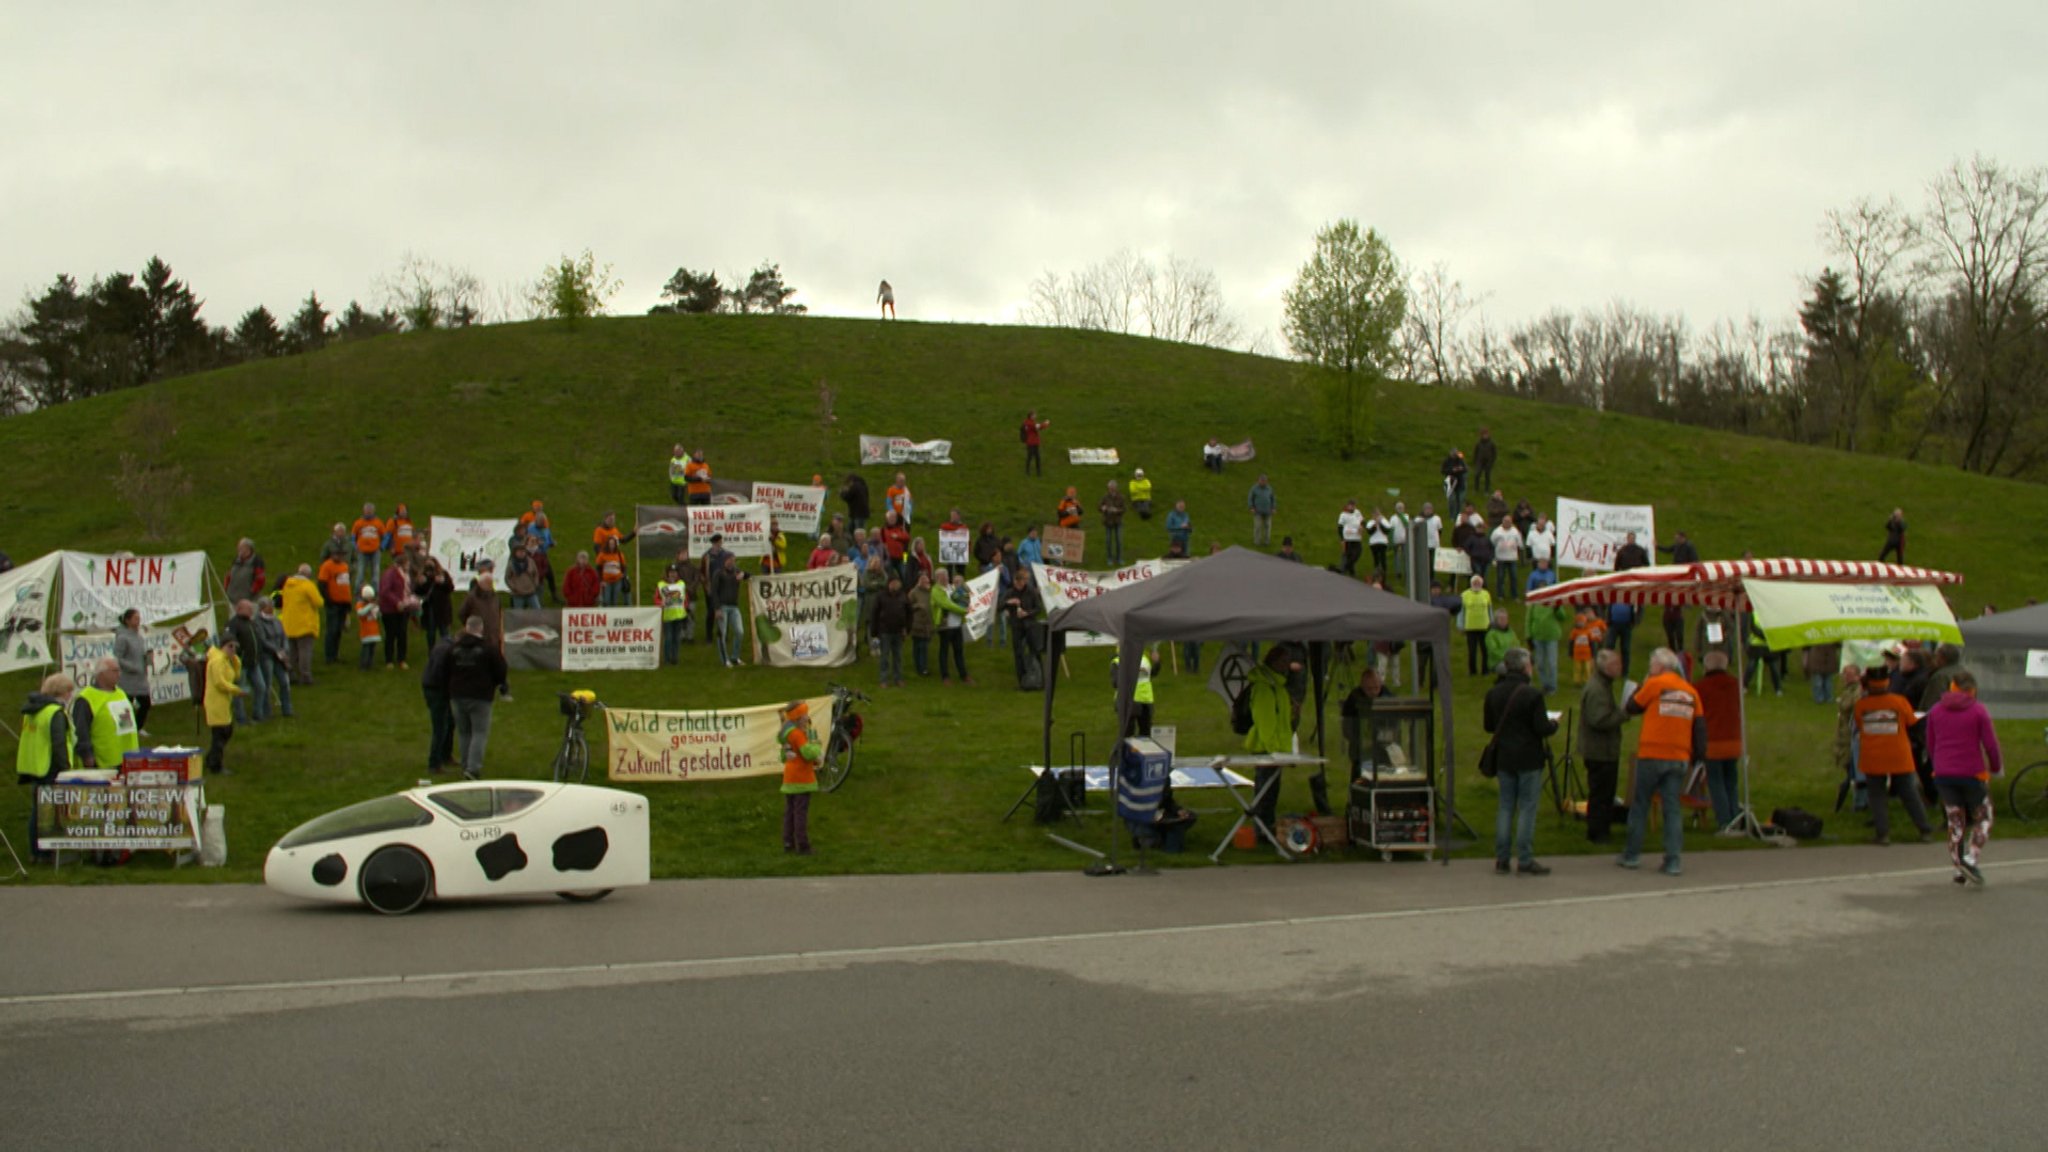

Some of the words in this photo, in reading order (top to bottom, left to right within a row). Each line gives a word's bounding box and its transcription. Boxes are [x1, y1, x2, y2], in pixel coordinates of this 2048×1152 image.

[756, 486, 785, 498] NEIN
[692, 509, 725, 520] NEIN
[693, 521, 763, 535] ICE-WERK
[1559, 534, 1609, 565] Nein!
[105, 557, 163, 585] NEIN
[1116, 564, 1153, 582] WEG
[759, 575, 855, 599] BAUMSCHUTZ
[567, 613, 607, 627] NEIN
[612, 618, 634, 627] ZUM
[567, 628, 654, 644] ICE-WERK
[567, 646, 578, 654] IN
[580, 645, 626, 655] UNSEREM
[629, 645, 654, 653] WALD
[610, 711, 659, 734] Wald
[666, 710, 745, 733] erhalten
[670, 733, 727, 750] gesunde
[615, 748, 672, 775] Zukunft
[679, 746, 752, 778] gestalten
[40, 789, 82, 804] NEIN
[88, 792, 124, 805] zum
[79, 806, 132, 822] Finger
[135, 808, 168, 823] weg
[66, 825, 99, 837] vom
[103, 823, 184, 837] Bannwald
